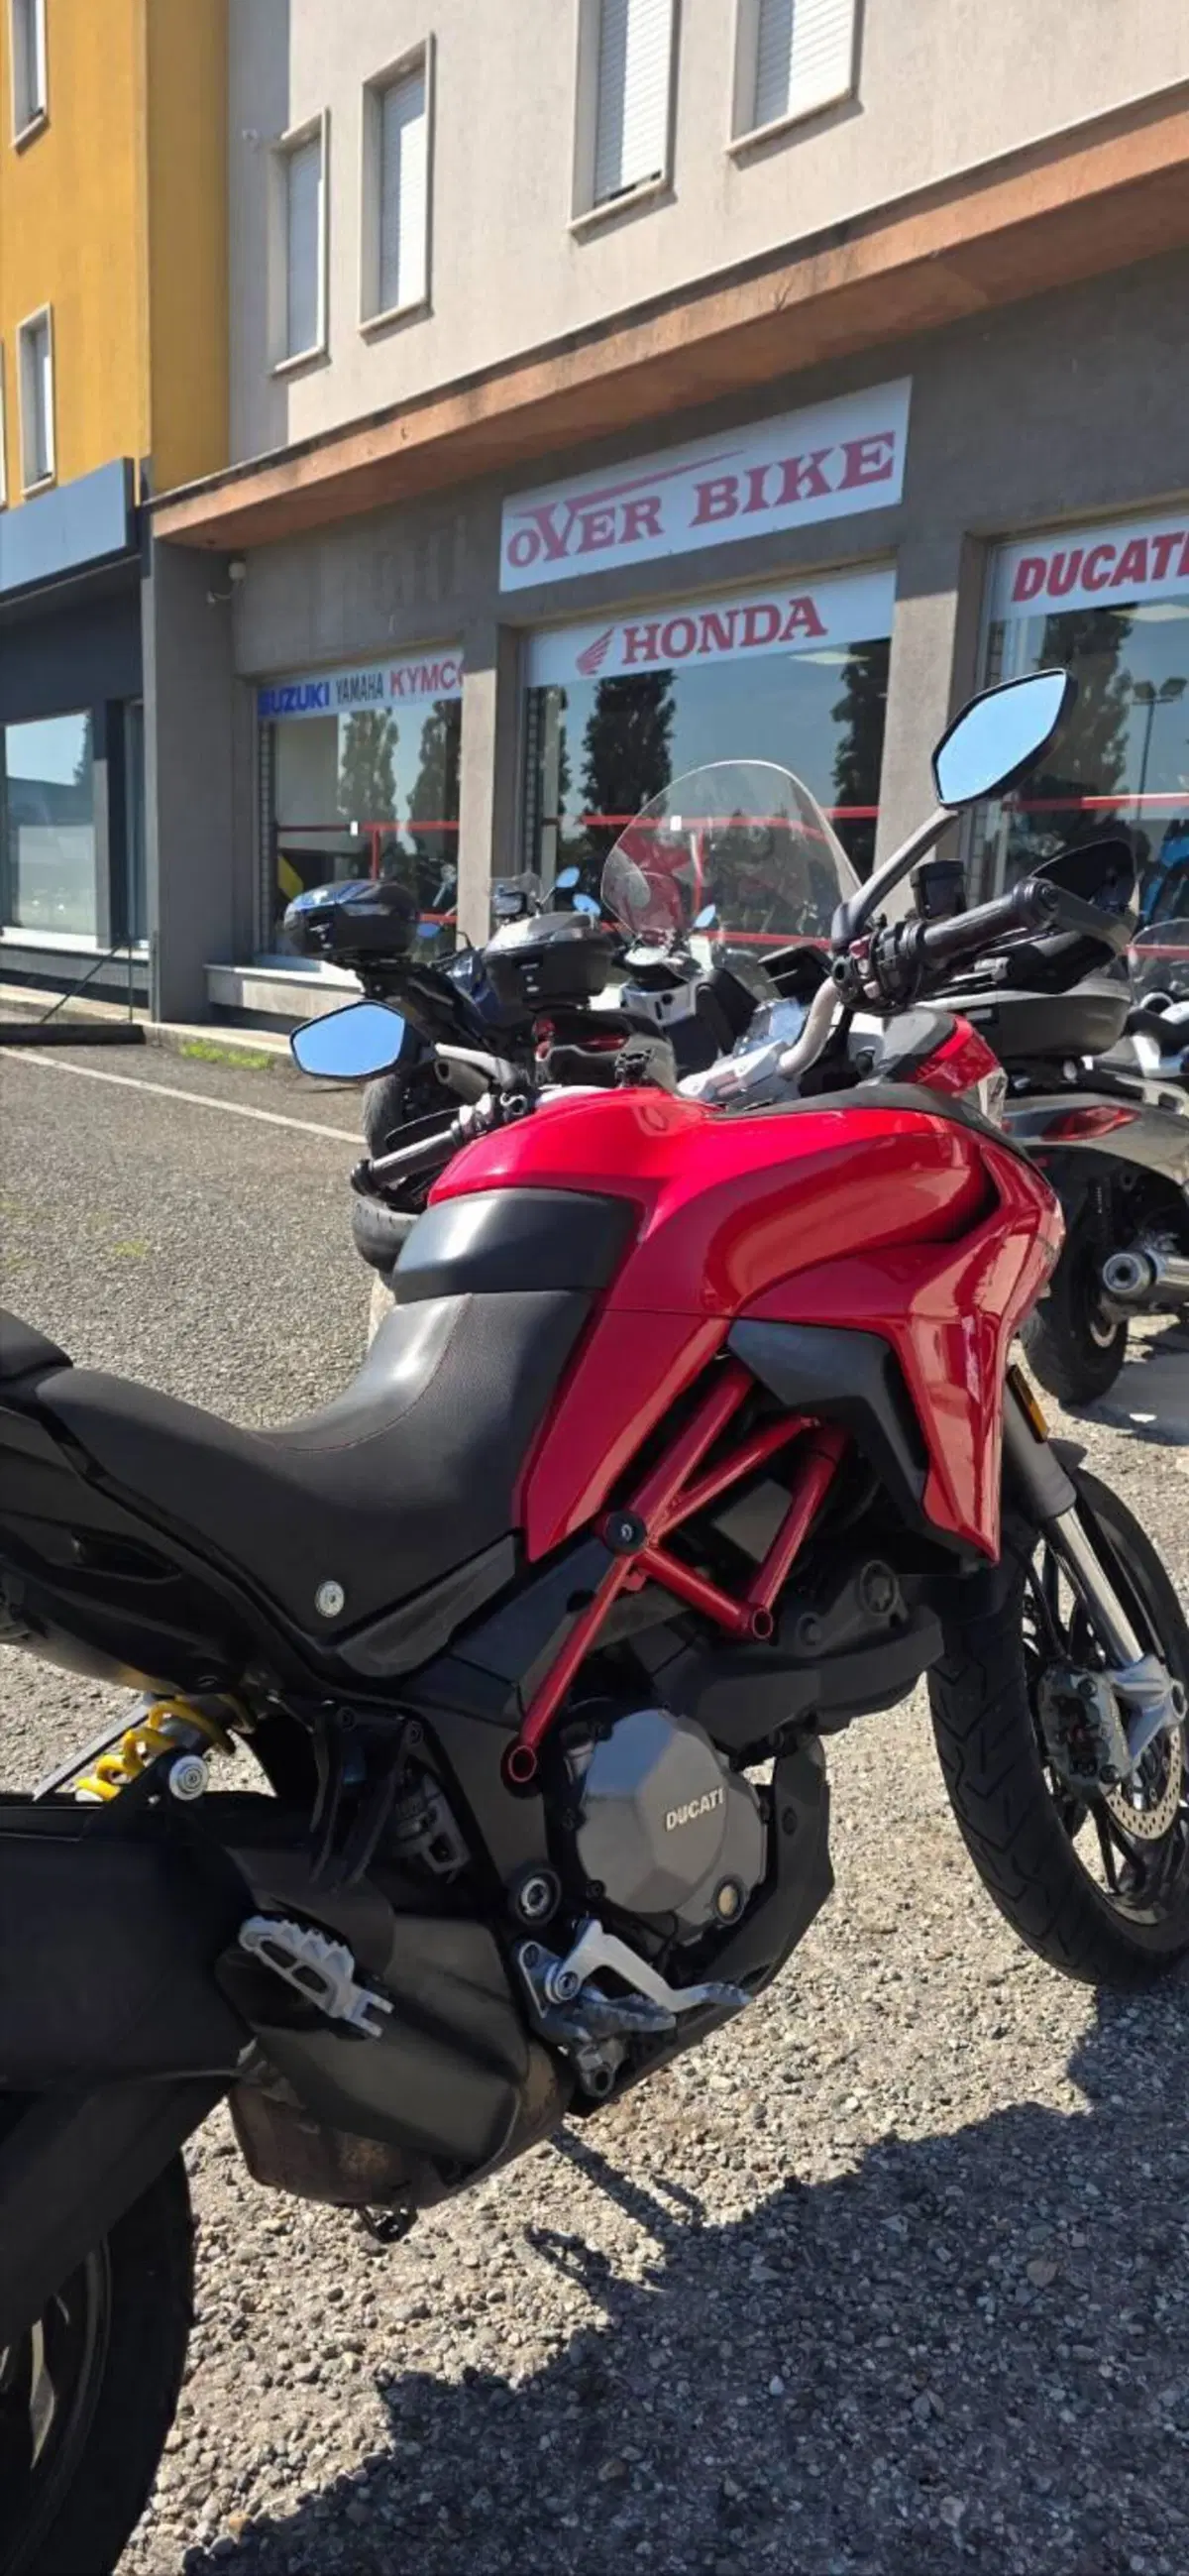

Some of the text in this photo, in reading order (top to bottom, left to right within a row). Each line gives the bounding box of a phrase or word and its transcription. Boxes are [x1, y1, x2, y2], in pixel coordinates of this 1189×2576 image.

[506, 430, 896, 568] OVER BIKE
[621, 596, 827, 665] HONDA
[336, 672, 384, 705] YAMAHA
[666, 1787, 723, 1832] DUCATI
